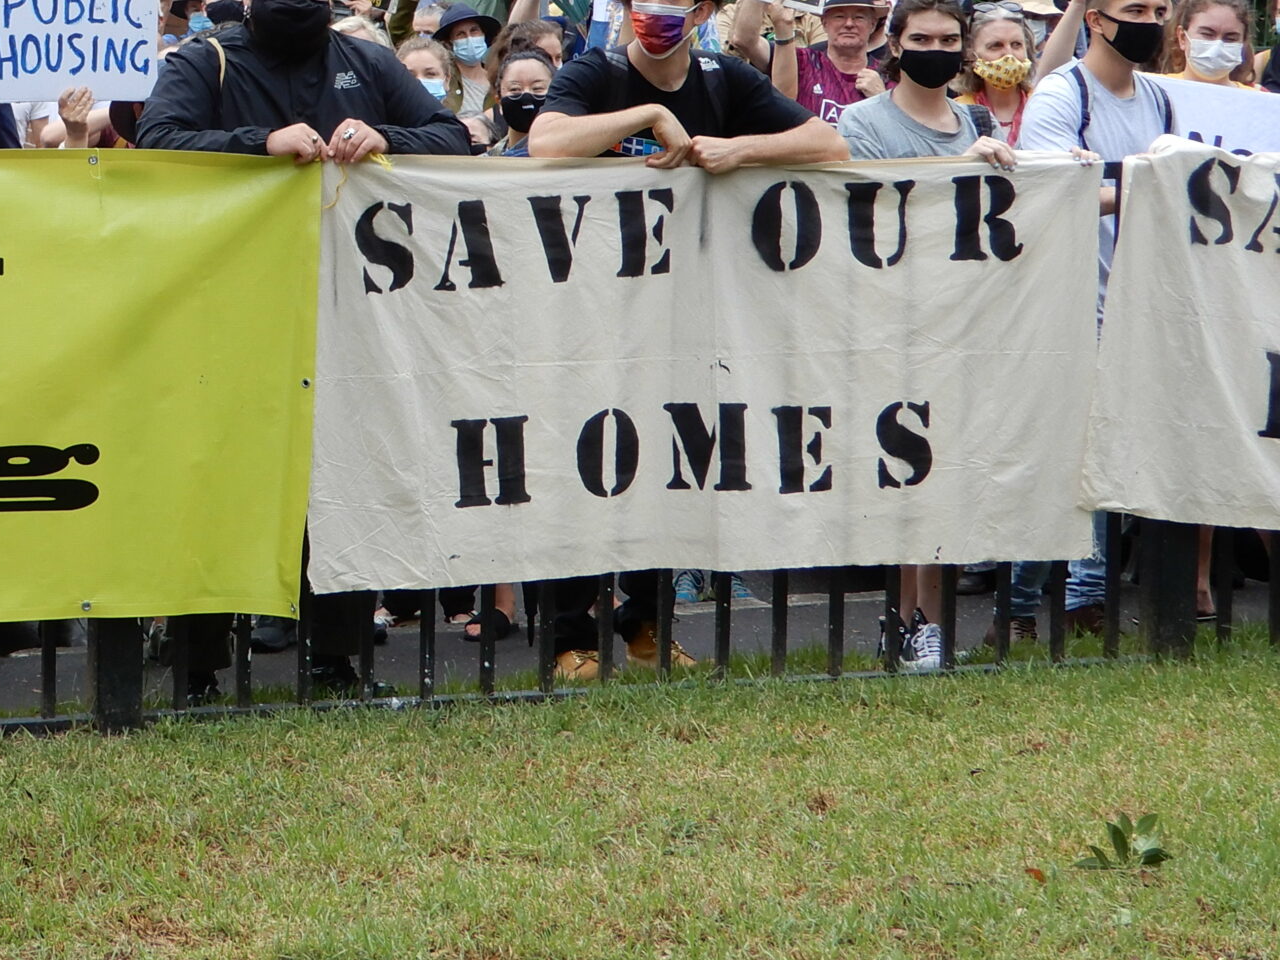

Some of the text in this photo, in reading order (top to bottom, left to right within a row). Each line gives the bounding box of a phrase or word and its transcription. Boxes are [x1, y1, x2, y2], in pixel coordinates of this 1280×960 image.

[355, 174, 1024, 295] SAVE OUR
[451, 400, 935, 509] HOMES
